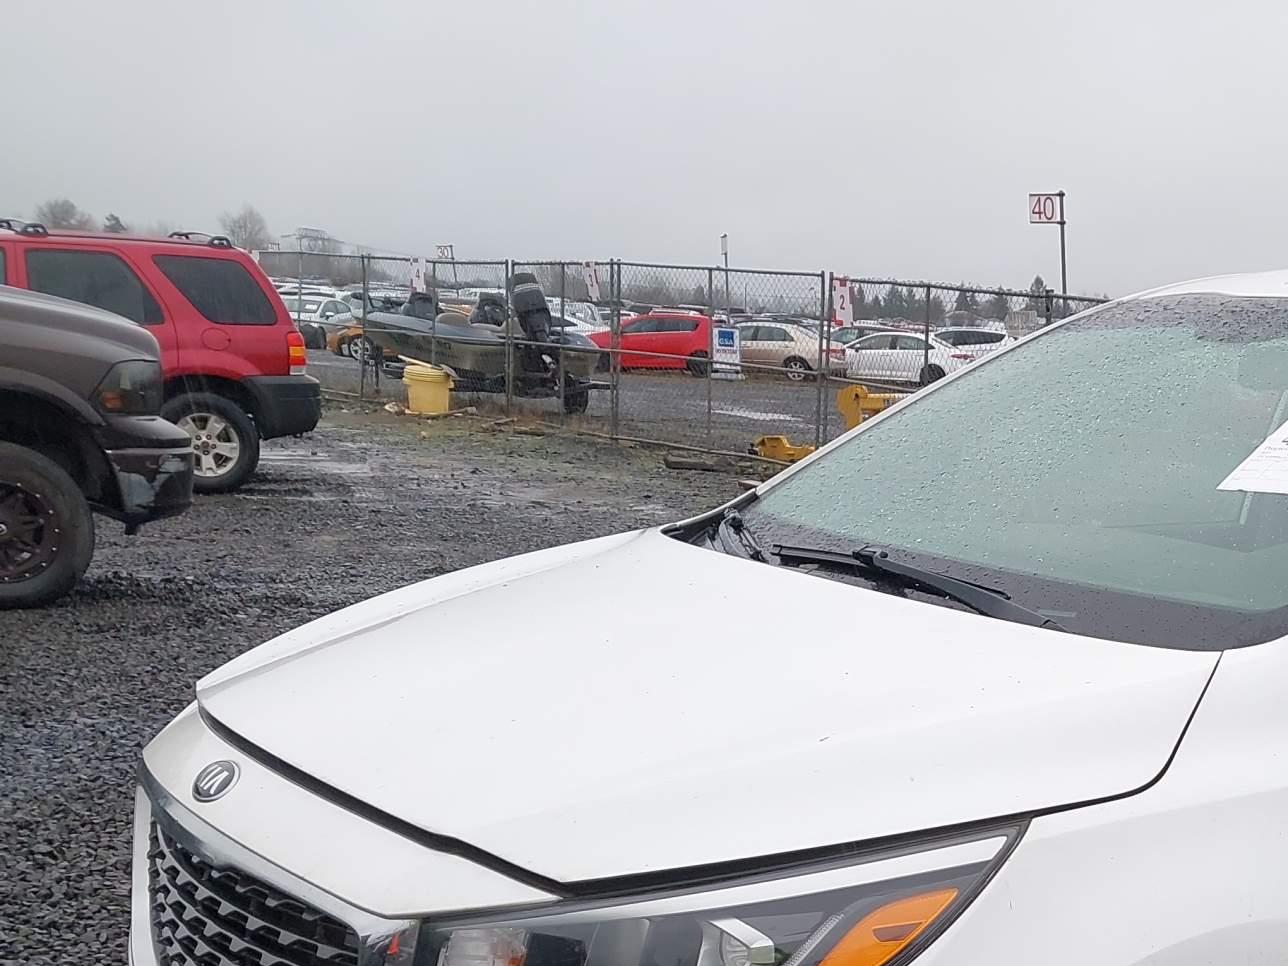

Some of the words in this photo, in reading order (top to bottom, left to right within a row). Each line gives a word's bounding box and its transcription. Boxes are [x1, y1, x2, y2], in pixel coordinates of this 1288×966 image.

[1032, 196, 1054, 220] 40
[437, 246, 449, 258] 30
[840, 294, 846, 310] 2
